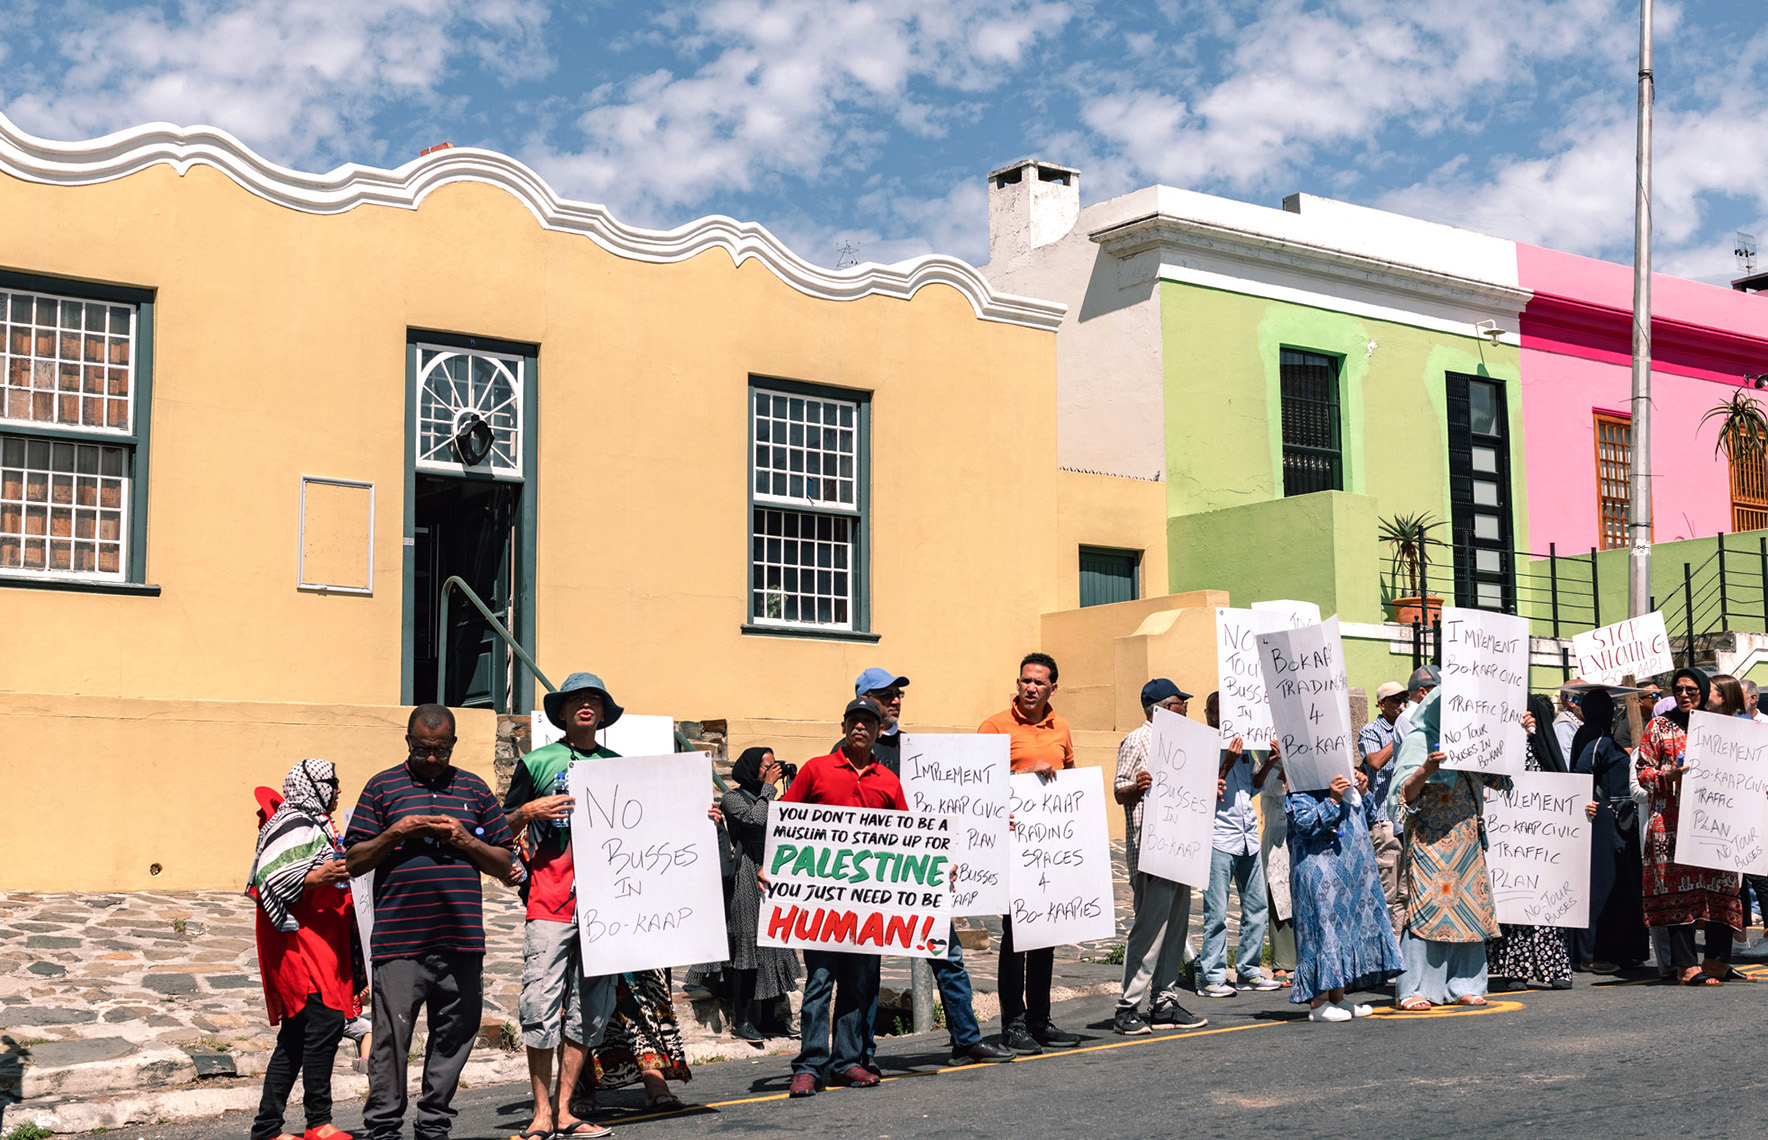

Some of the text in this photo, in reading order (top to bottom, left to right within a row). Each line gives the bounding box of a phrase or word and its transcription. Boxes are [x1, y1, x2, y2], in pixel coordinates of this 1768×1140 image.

[1224, 623, 1255, 650] NO
[1592, 619, 1640, 650] STOP
[1226, 651, 1262, 679] TOU
[1579, 633, 1666, 676] EXPLOITING
[1237, 705, 1252, 719] IN
[1309, 702, 1324, 725] 4
[1448, 694, 1523, 724] TRAFFIC PLAN
[1444, 722, 1488, 745] NO TOUR
[1692, 725, 1768, 763] IMPLEMENT
[1157, 731, 1187, 770] NO
[1449, 738, 1492, 765] BUSES IN
[907, 753, 997, 786] IMPLEMENT
[1156, 771, 1208, 814] BUSSES
[1485, 788, 1580, 816] IMPLEMENT
[1694, 787, 1734, 808] TRAFFIC
[586, 784, 643, 830] NO
[778, 806, 948, 832] YOU DON'T HAVE TO BE A
[972, 798, 1006, 819] CIVIC
[1162, 805, 1179, 824] IN
[772, 824, 827, 841] MUSLIM
[831, 829, 849, 843] TO
[851, 830, 899, 846] STAND
[902, 835, 922, 848] UP
[925, 836, 951, 850] FOR
[1013, 820, 1075, 843] TRADING
[1542, 823, 1581, 838] CIVIC
[1693, 809, 1731, 838] PLAN
[966, 828, 996, 851] PLAN
[1494, 841, 1562, 865] TRAFFIC
[1716, 827, 1759, 861] NO TOUR
[601, 837, 698, 875] BUSSES
[770, 844, 949, 887] PALESTINE
[1022, 848, 1084, 868] SPACES
[1734, 845, 1763, 869] BUSES
[614, 876, 642, 898] IN
[958, 862, 999, 886] BUSSES
[1038, 871, 1051, 894] 4
[1490, 868, 1539, 889] PLAN
[767, 881, 942, 908] YOU JUST NEED TO BE
[1544, 897, 1578, 925] BUSES
[584, 906, 693, 944] BO-KAAP
[767, 904, 935, 950] HUMAN!
